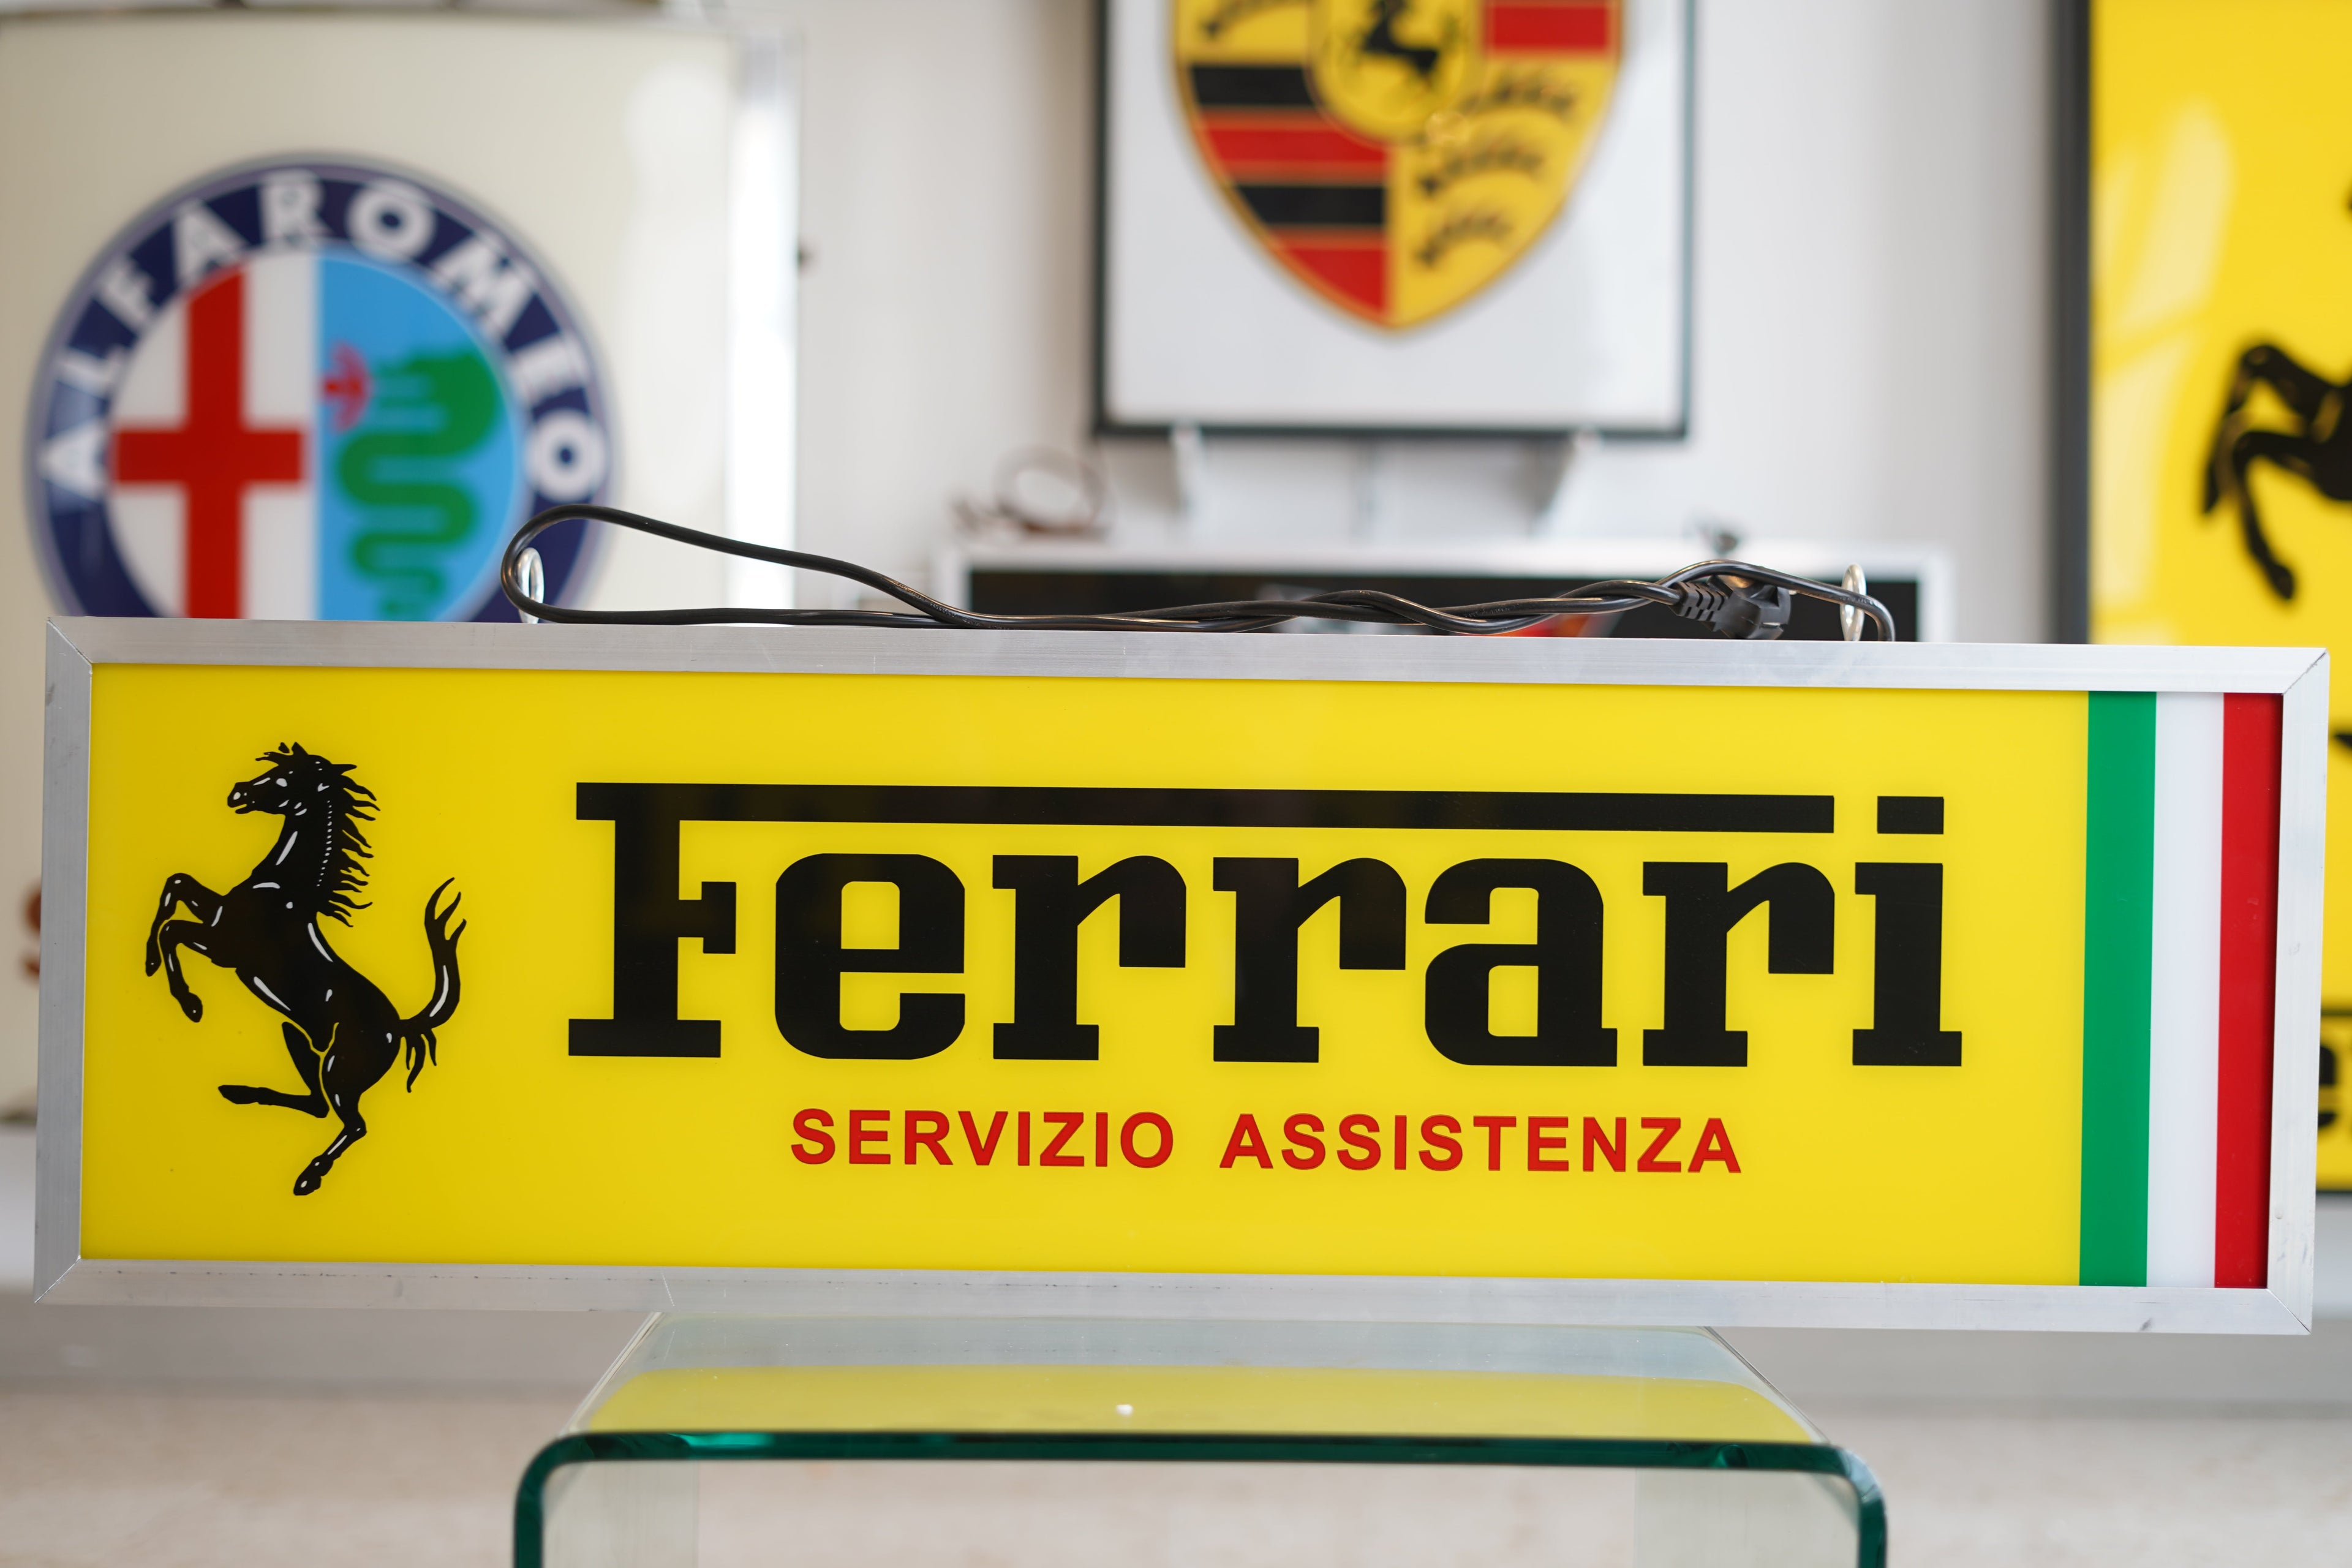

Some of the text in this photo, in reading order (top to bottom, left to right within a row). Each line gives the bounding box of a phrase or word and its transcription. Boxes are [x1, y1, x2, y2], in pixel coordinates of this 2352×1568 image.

[568, 783, 1962, 1067] Ferrari
[791, 1108, 1742, 1174] SERVIZIO ASSISTENZA
